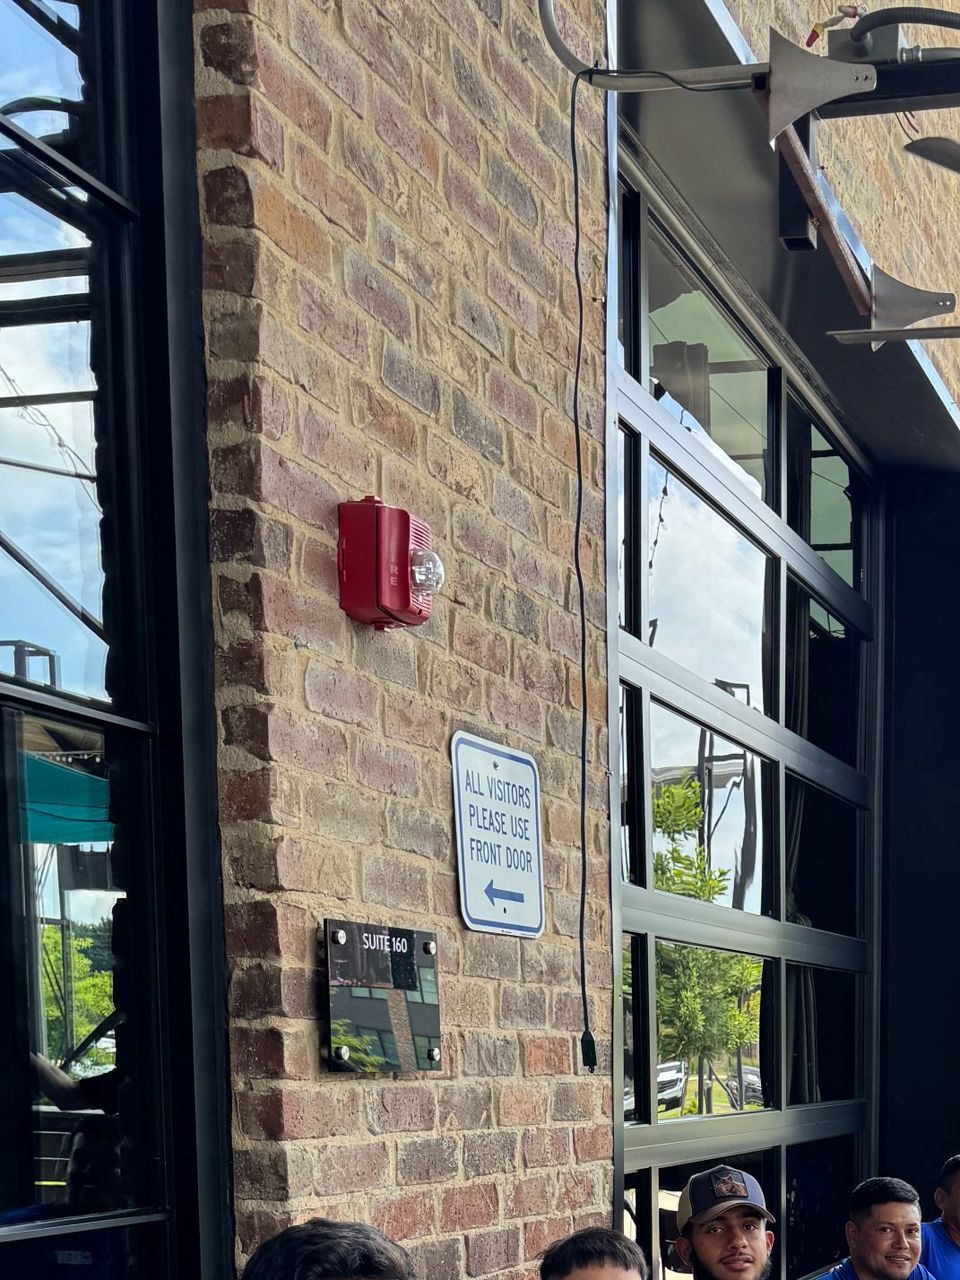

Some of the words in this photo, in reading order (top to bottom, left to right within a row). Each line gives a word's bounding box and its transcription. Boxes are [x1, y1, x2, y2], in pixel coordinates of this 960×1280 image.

[465, 769, 484, 796] ALL
[487, 777, 531, 809] VISITORS
[469, 804, 507, 836] PLEASE
[511, 816, 530, 841] USE
[469, 838, 502, 867] FRONT
[506, 846, 533, 873] DOOR
[363, 933, 391, 951] SUITE
[392, 936, 408, 953] 160
